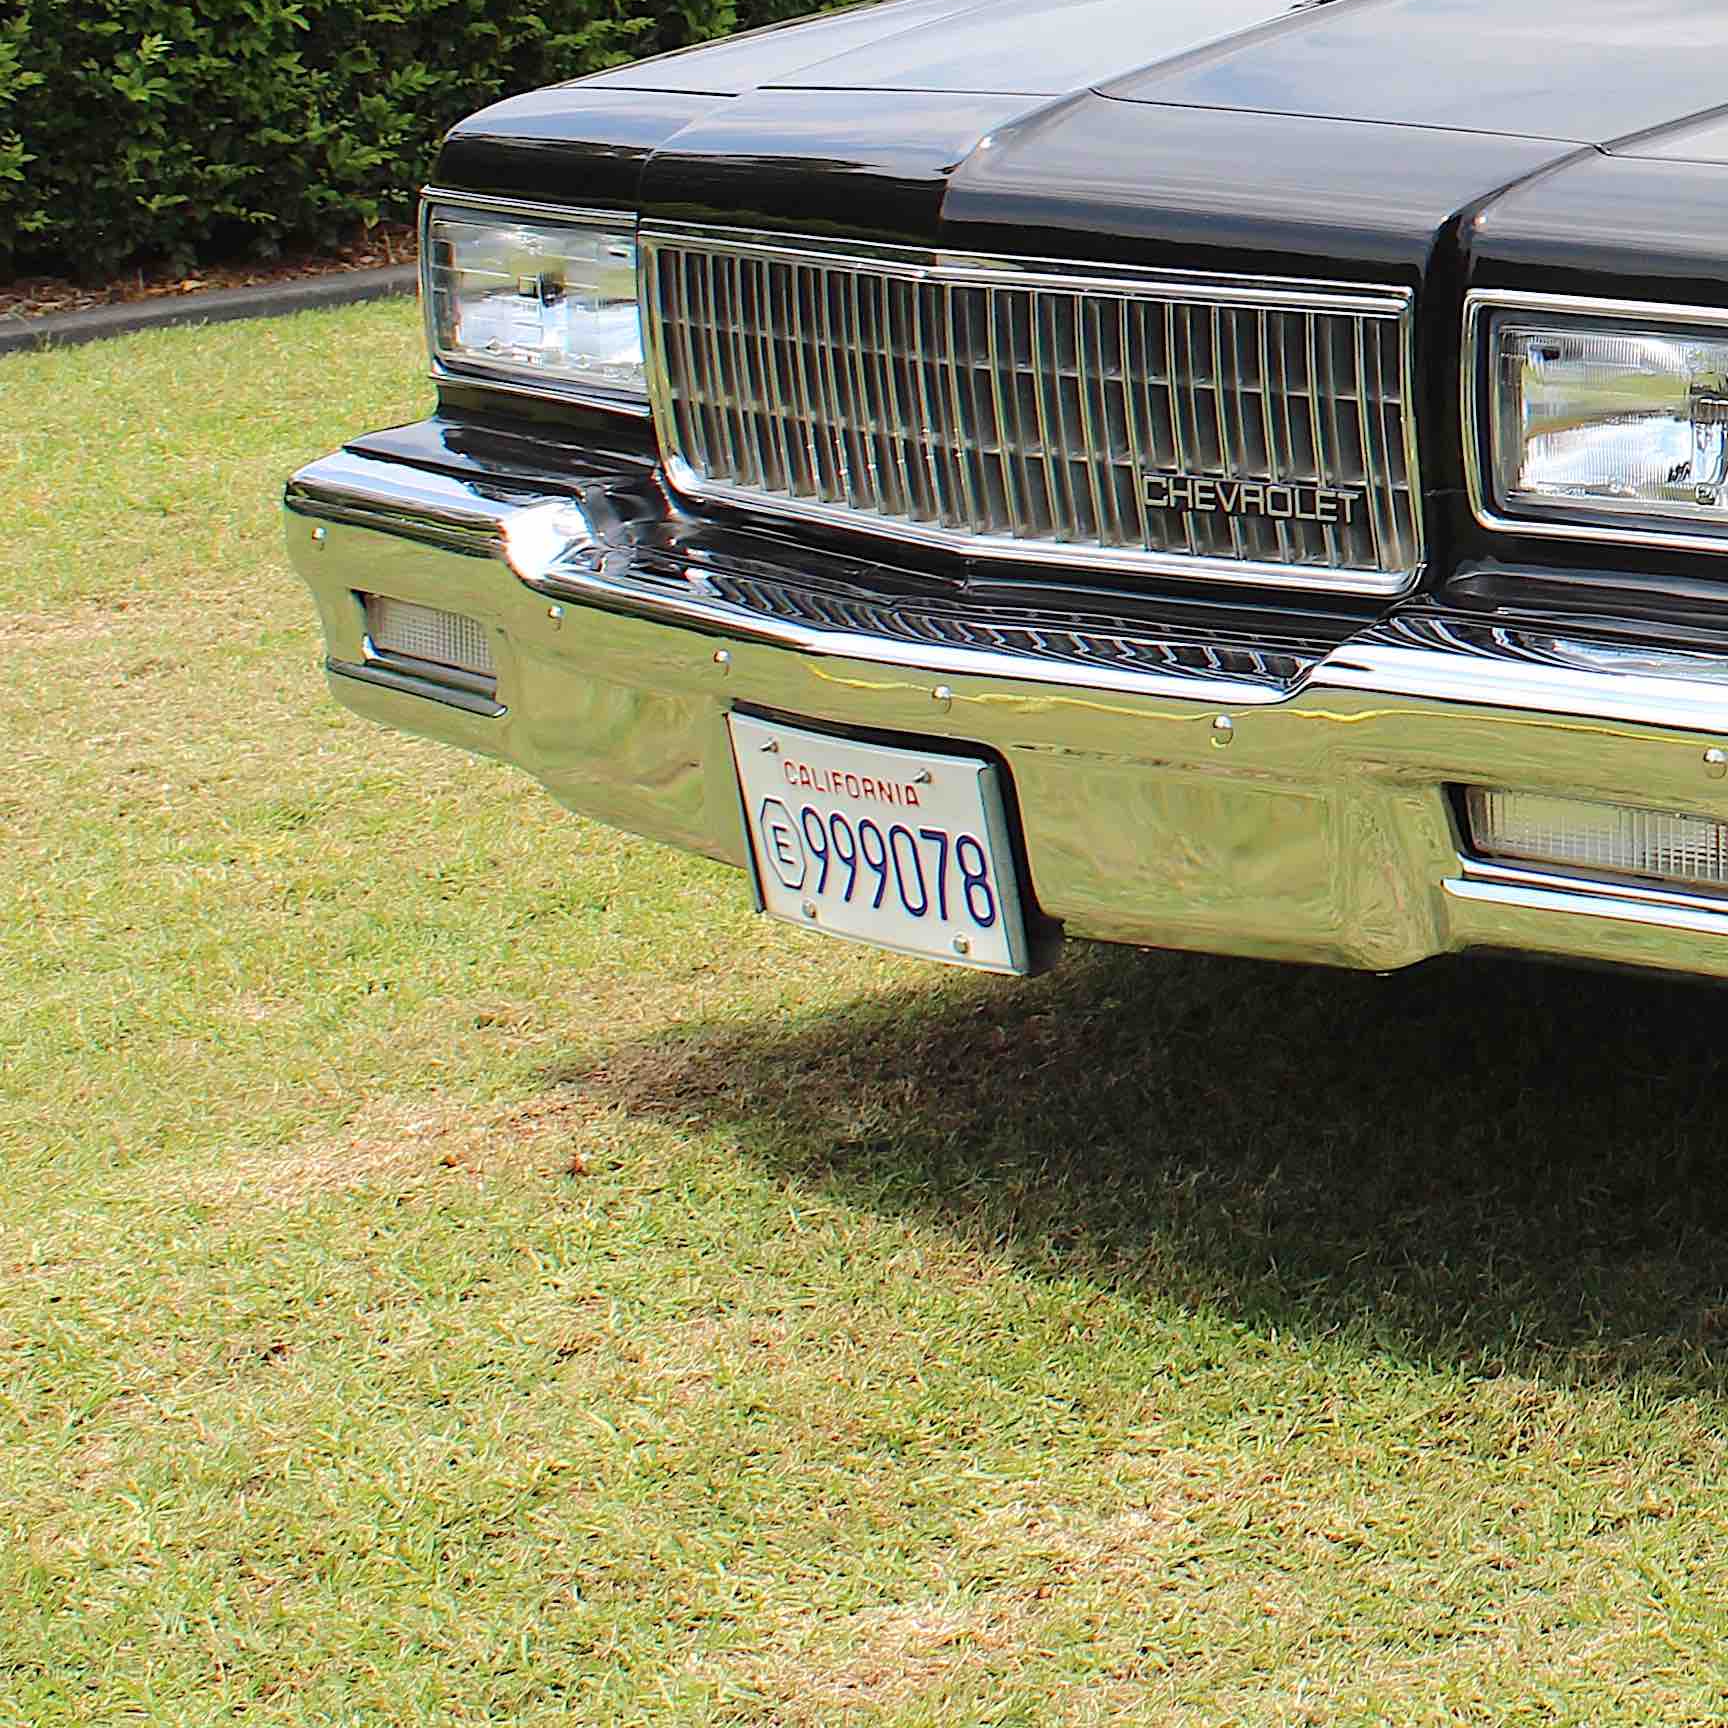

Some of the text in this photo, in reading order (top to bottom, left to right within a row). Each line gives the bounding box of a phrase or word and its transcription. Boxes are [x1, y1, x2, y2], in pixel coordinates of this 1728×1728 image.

[1143, 475, 1358, 523] CHEVROLET
[783, 760, 920, 807] CALIFORNIA
[801, 805, 996, 928] 999078
